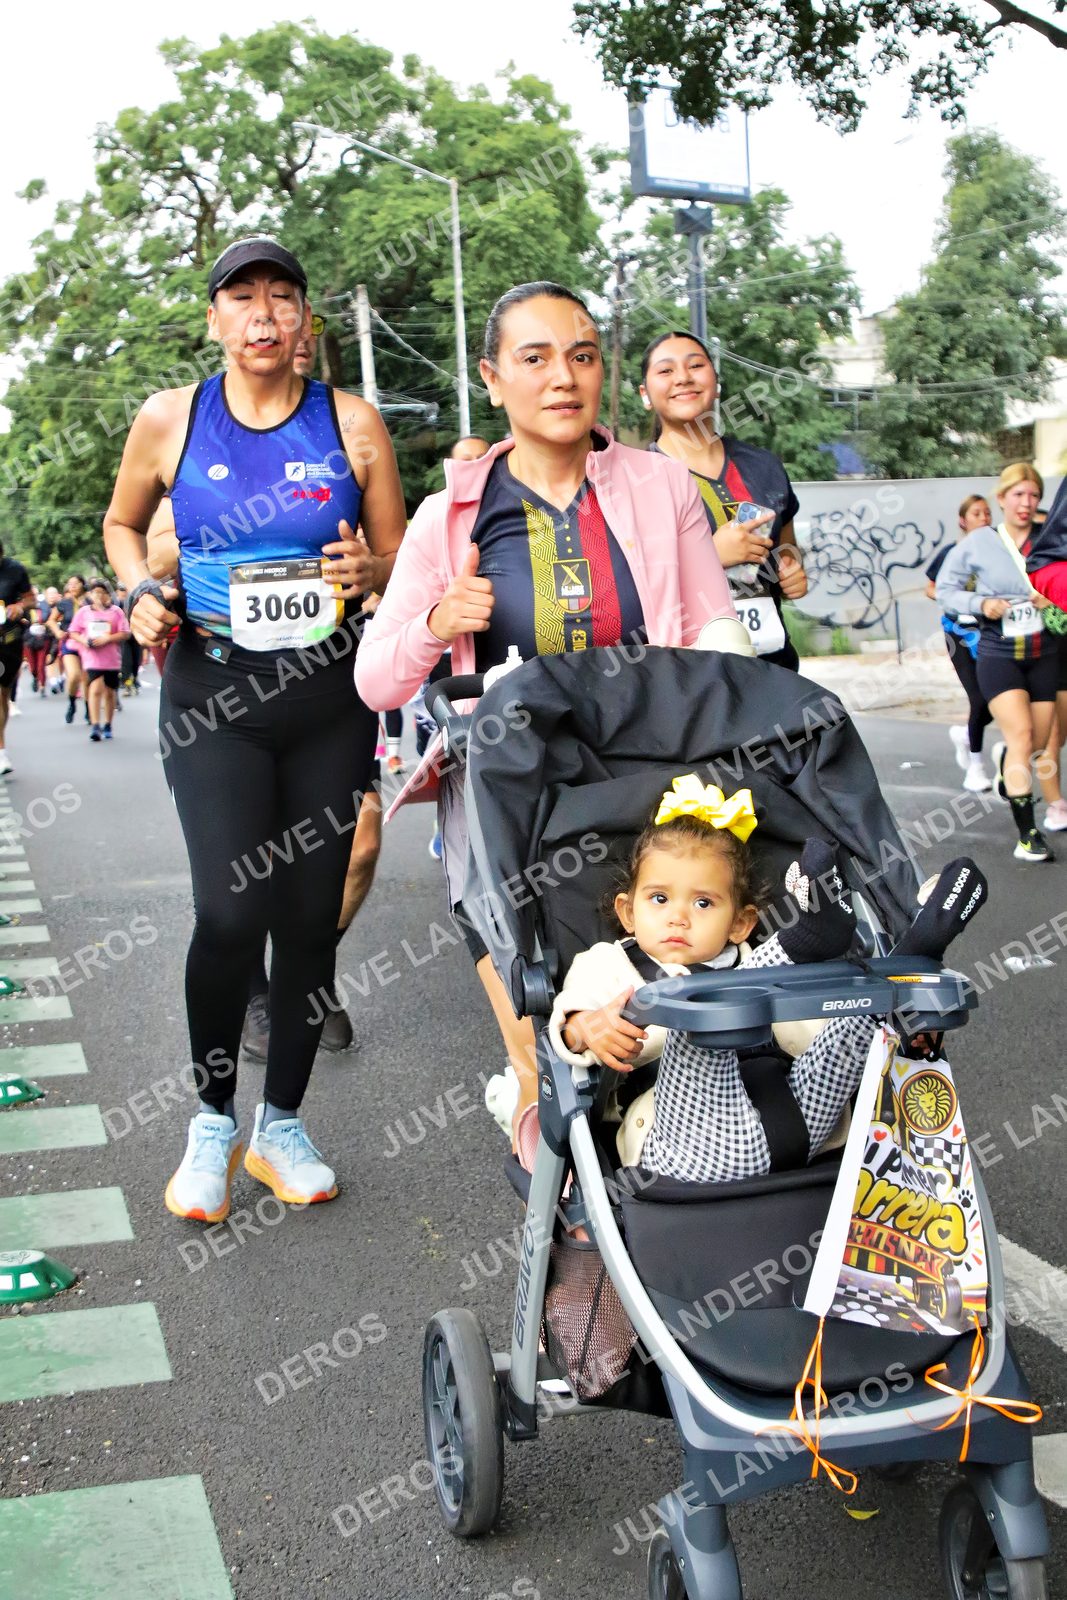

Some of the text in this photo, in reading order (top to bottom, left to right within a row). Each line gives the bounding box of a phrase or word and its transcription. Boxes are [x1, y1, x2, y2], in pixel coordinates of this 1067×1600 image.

[246, 590, 321, 623] 3060
[942, 867, 971, 911] KIDS SOCKS
[822, 998, 872, 1012] BRAVO
[514, 1225, 536, 1350] BRAVO
